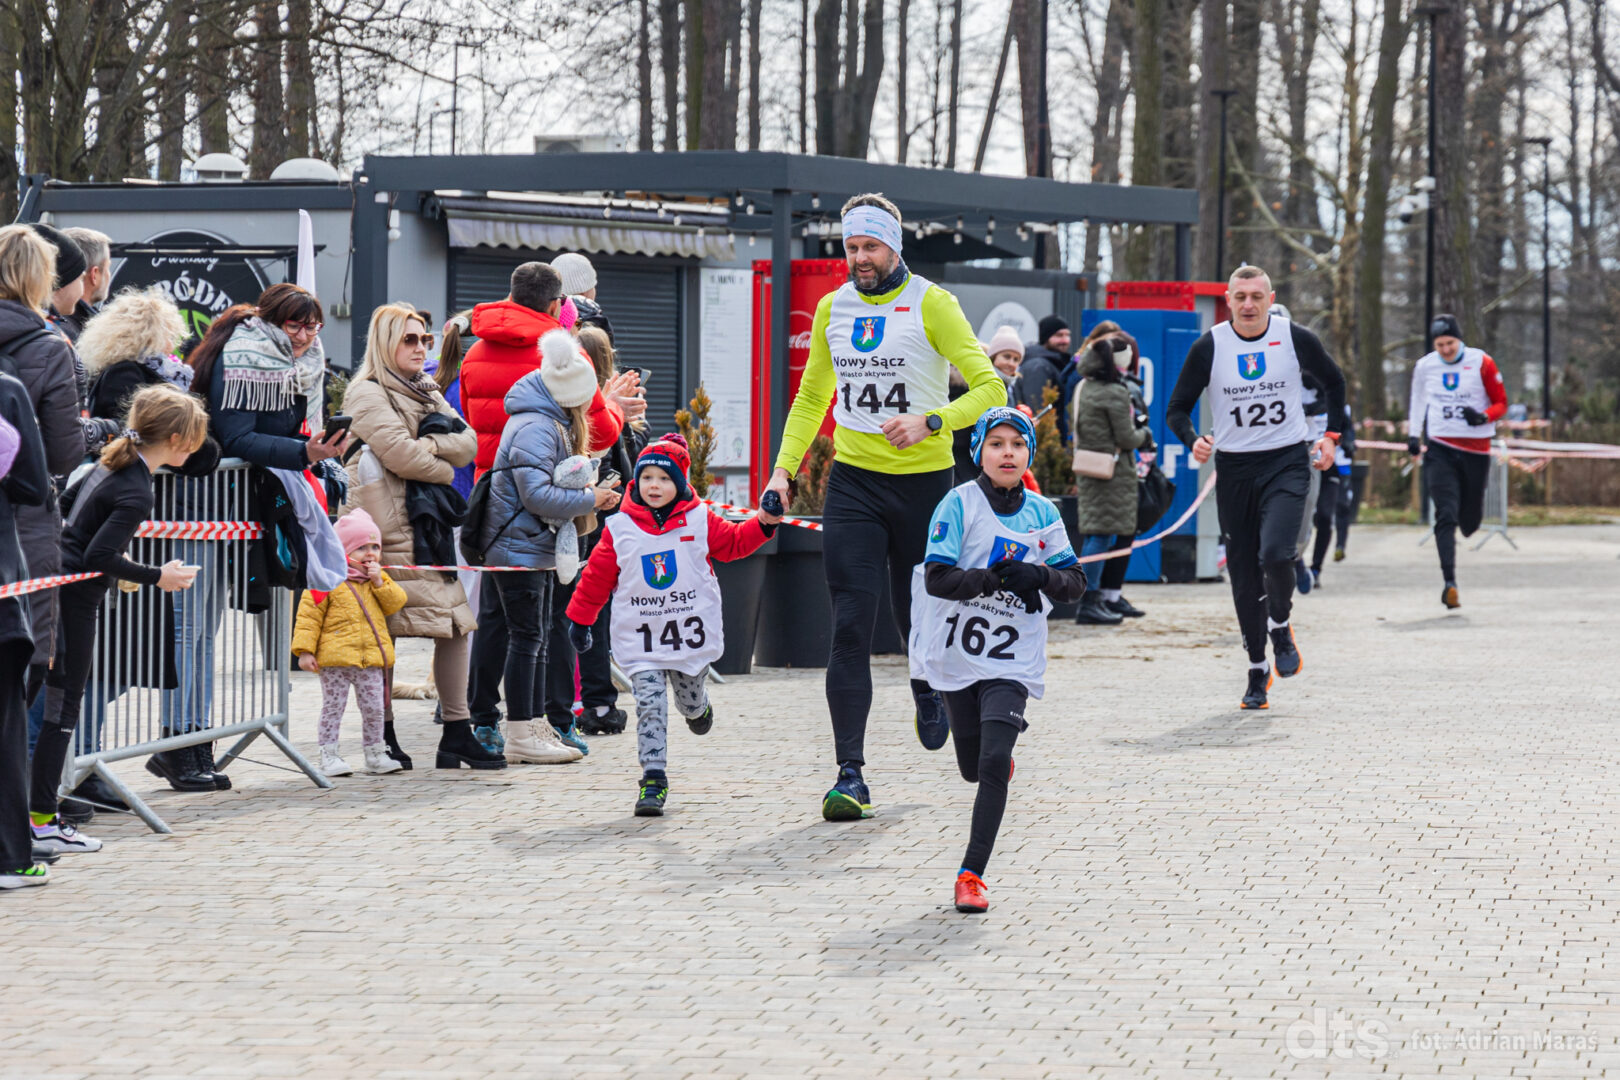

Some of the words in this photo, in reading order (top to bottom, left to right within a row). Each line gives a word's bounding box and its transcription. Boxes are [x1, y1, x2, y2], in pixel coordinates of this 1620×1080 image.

[833, 356, 867, 369] Nowy
[871, 356, 906, 369] Sącz
[864, 370, 896, 379] aktywne
[1223, 384, 1256, 395] Nowy
[1259, 381, 1286, 391] Sącz
[841, 382, 911, 414] 144
[1253, 392, 1278, 400] aktywne
[1230, 400, 1286, 428] 123
[1443, 405, 1465, 419] 53
[631, 595, 666, 607] Nowy
[664, 605, 694, 615] aktywne
[980, 603, 1015, 619] aktywne
[636, 615, 706, 653] 143
[945, 613, 1020, 660] 162
